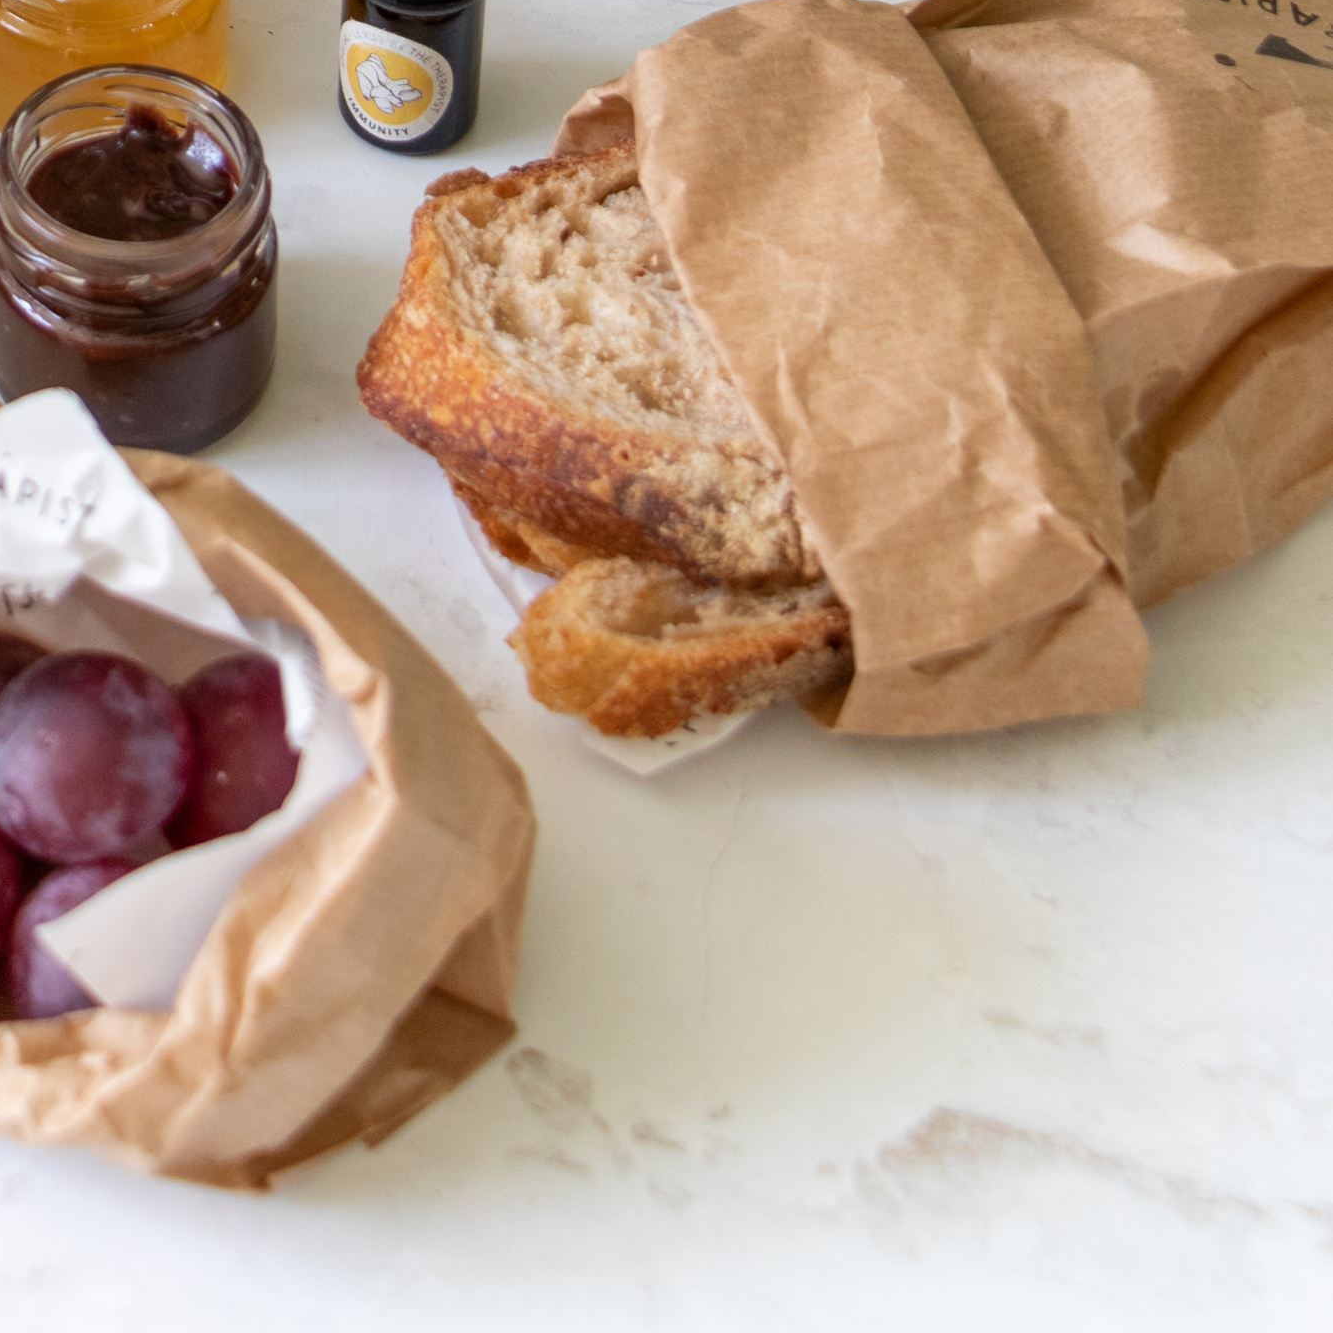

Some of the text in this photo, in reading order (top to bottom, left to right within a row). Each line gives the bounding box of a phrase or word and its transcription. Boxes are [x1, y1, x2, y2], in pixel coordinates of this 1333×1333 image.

[410, 46, 432, 64] THE
[430, 61, 447, 113] THERAPIST
[348, 97, 409, 136] IMMUNITY
